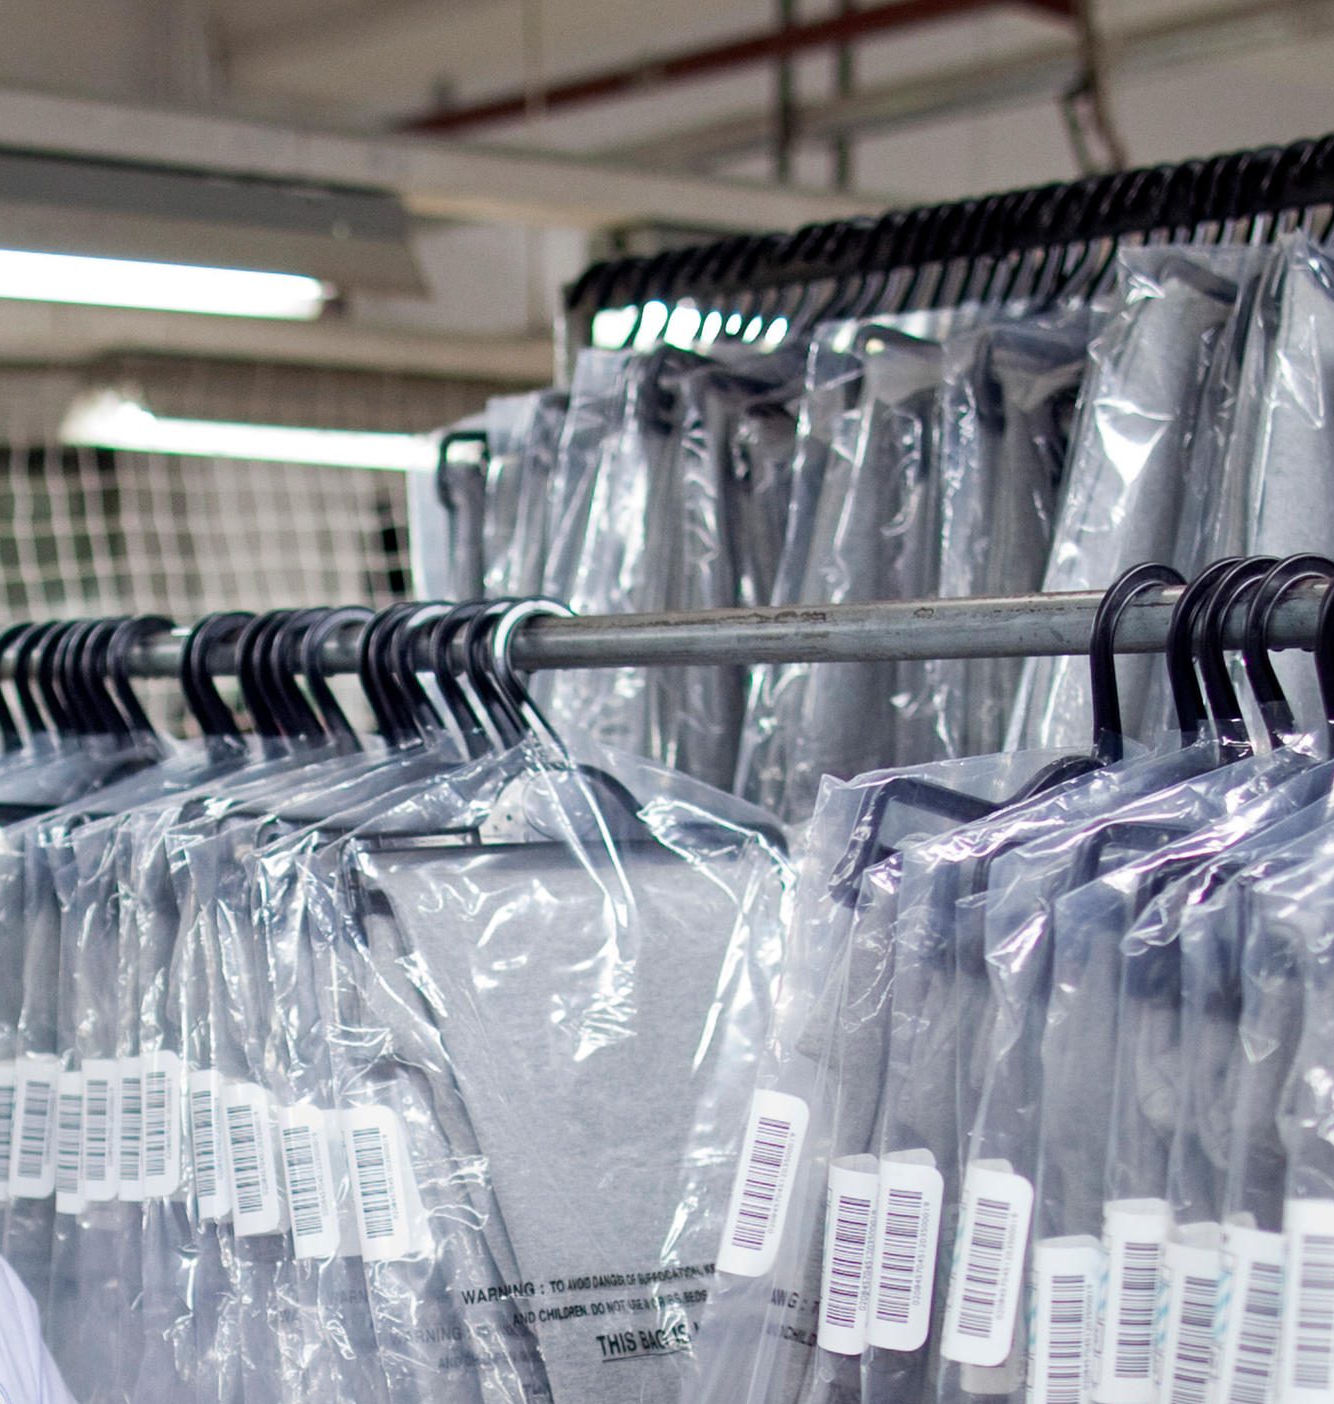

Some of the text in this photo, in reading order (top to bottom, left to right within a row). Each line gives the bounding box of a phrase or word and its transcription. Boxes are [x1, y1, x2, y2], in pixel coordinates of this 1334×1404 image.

[461, 1282, 535, 1305] WARNING
[549, 1280, 565, 1293] TO
[567, 1276, 591, 1291] AVOID
[592, 1274, 625, 1289] DANGER
[513, 1311, 536, 1325] AND
[590, 1302, 605, 1316] DO
[607, 1300, 624, 1313] NOT
[595, 1324, 691, 1356] THIS BAG IS
